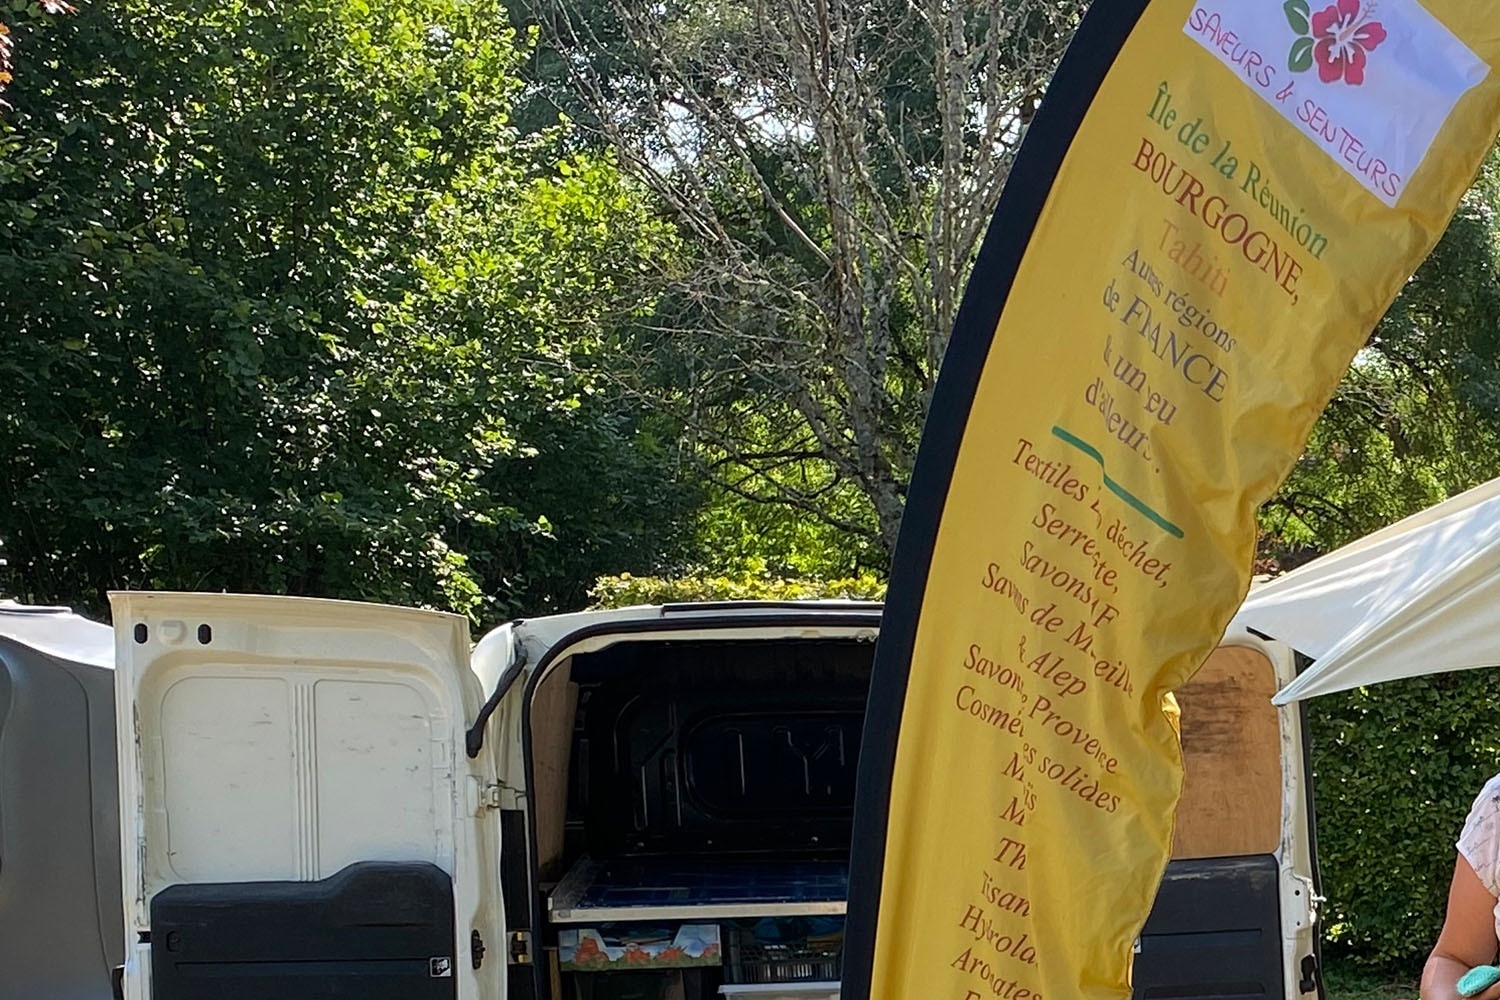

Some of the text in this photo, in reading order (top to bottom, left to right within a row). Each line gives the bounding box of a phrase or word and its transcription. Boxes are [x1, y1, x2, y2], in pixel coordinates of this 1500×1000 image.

[1188, 8, 1276, 88] SAVEURS
[1296, 99, 1400, 197] SENTEURS
[1146, 80, 1328, 260] Île de la Réunion
[1131, 137, 1303, 306] BOURGOGNE,
[1163, 292, 1237, 353] régions
[1113, 355, 1147, 394] un
[1012, 438, 1172, 589] Textiles déchet,
[1030, 603, 1064, 632] de
[1027, 652, 1087, 698] Alep
[1038, 756, 1121, 813] solides
